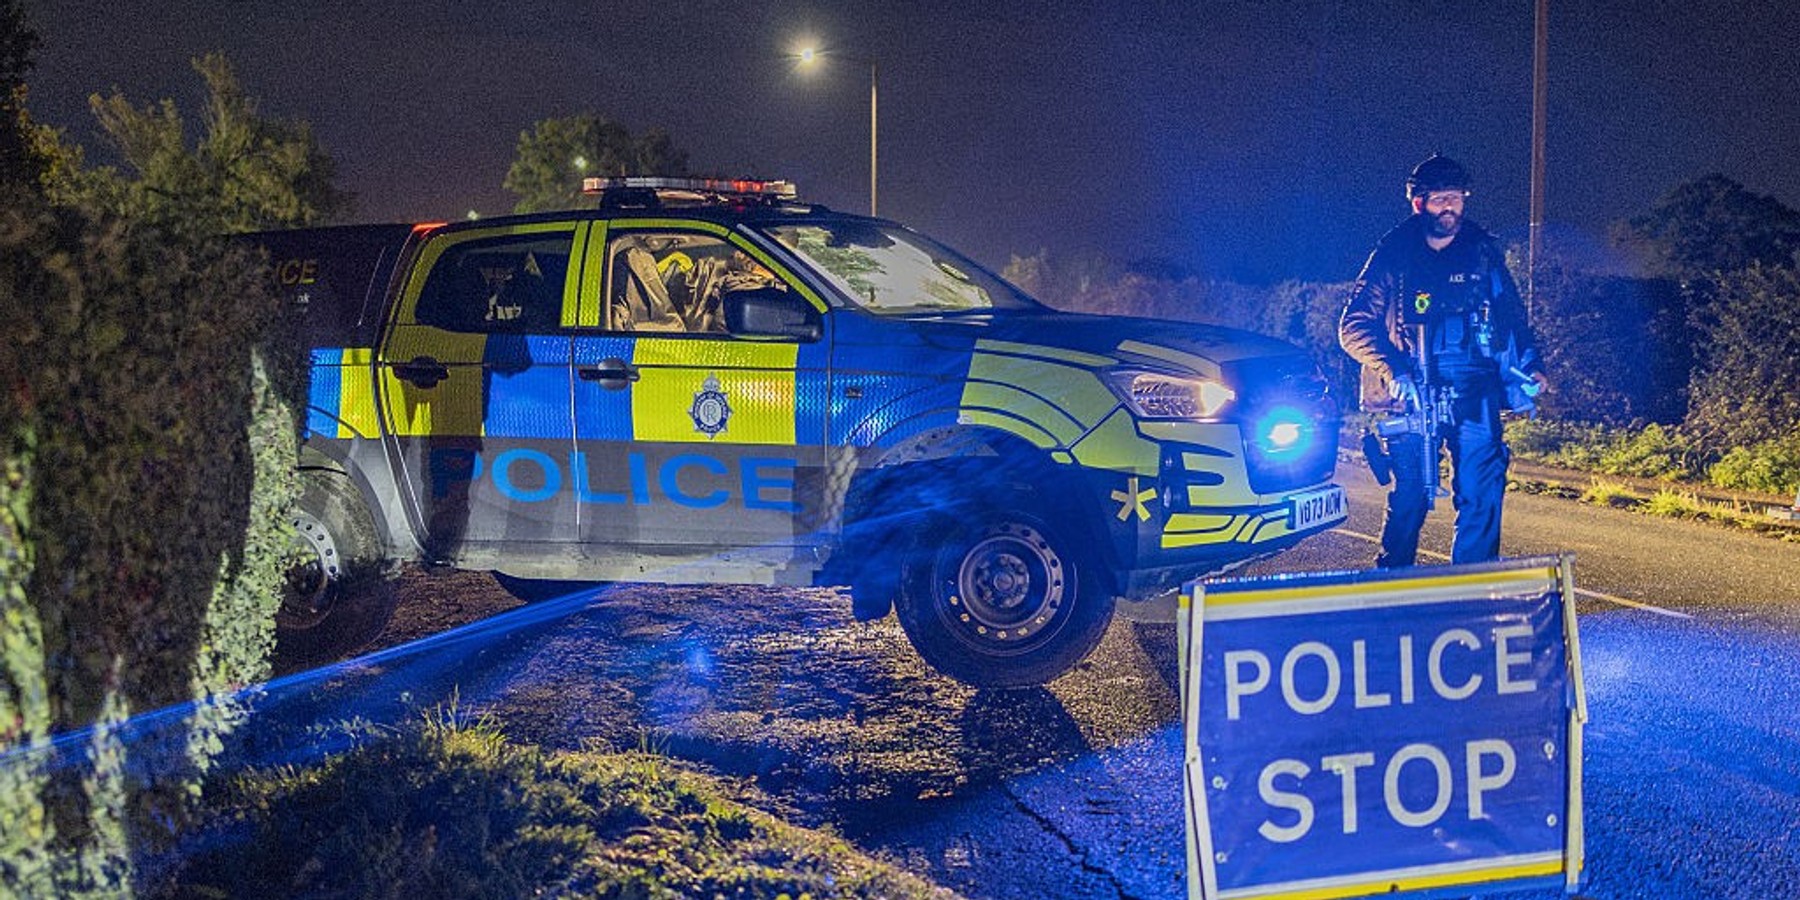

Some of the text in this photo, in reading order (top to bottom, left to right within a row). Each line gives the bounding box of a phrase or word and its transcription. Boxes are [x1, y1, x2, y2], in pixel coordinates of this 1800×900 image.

[430, 447, 805, 514] POLICE
[1224, 625, 1538, 720] POLICE
[1258, 739, 1517, 843] STOP
